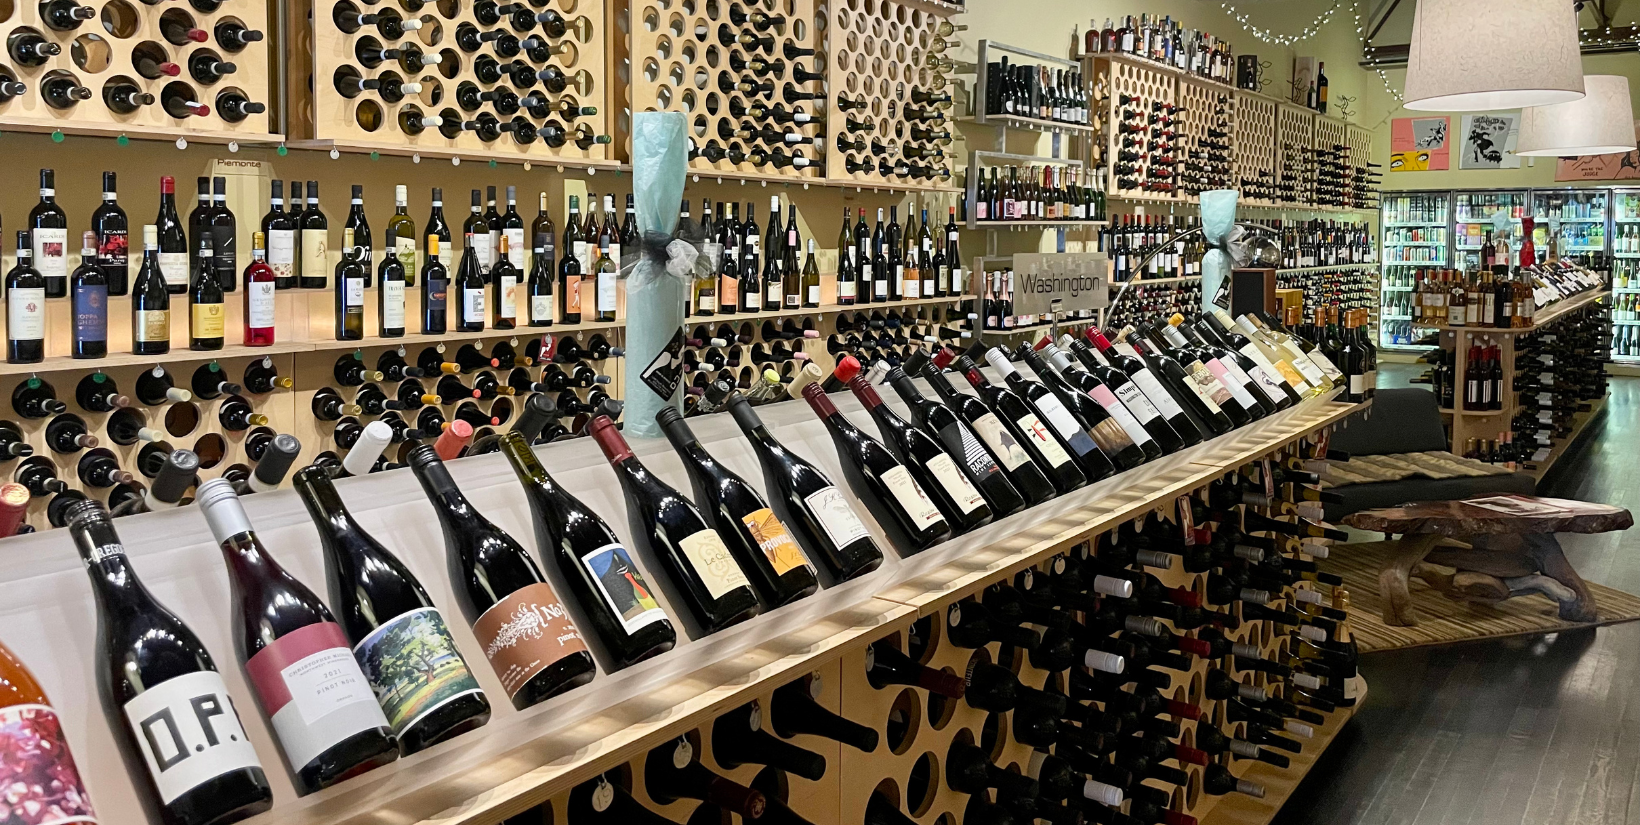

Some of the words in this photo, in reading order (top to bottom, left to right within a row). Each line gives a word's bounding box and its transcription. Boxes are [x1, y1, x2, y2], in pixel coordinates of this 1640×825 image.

[217, 159, 262, 168] Piemonte
[1020, 273, 1100, 298] Washington
[703, 557, 716, 566] Le
[556, 632, 577, 647] pinot
[288, 654, 332, 678] CHRISTOPHER
[323, 668, 342, 678] 2021
[316, 682, 339, 696] PINOT
[341, 677, 357, 685] NOIR
